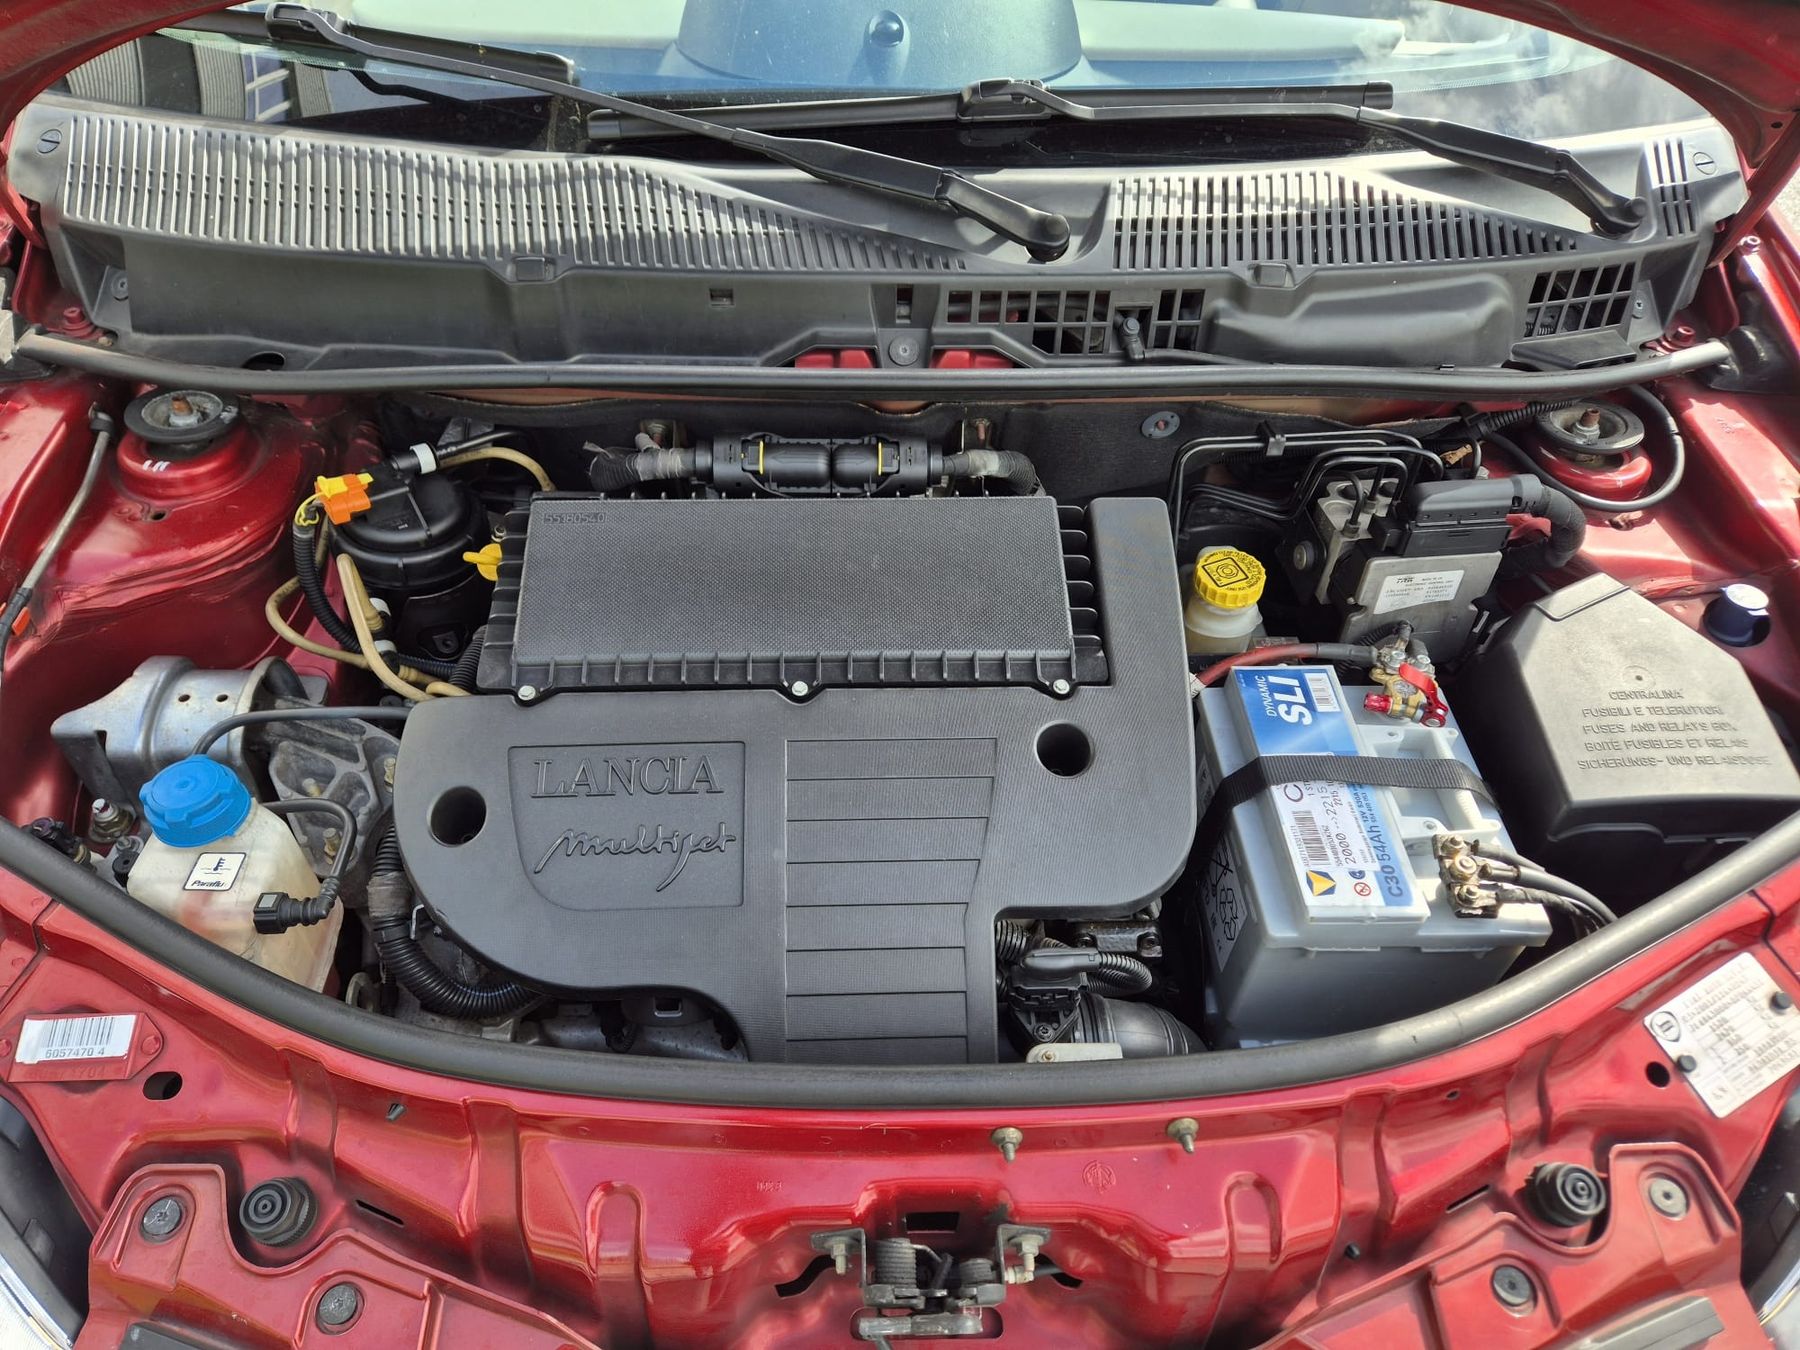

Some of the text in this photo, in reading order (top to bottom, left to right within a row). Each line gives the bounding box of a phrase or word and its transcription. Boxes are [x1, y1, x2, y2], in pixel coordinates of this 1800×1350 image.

[1254, 675, 1277, 717] DYNAMIC
[1267, 675, 1313, 725] SLI
[1608, 688, 1684, 700] CENTRALINA
[1582, 705, 1725, 718] FUSIBILI E TELERUTTORI
[1582, 723, 1625, 735] FUSES
[1630, 723, 1656, 733] AND
[1659, 721, 1708, 732] RELAYS
[1624, 738, 1684, 750] FUSIBLES
[1687, 738, 1702, 749] ET
[1666, 755, 1693, 766] UND
[531, 755, 724, 798] LANCIA
[1359, 810, 1369, 822] 12V
[1335, 833, 1356, 864] 2000
[1367, 825, 1391, 861] 54Ah
[1380, 865, 1403, 897] C30
[45, 1047, 105, 1059] 6057470 4
